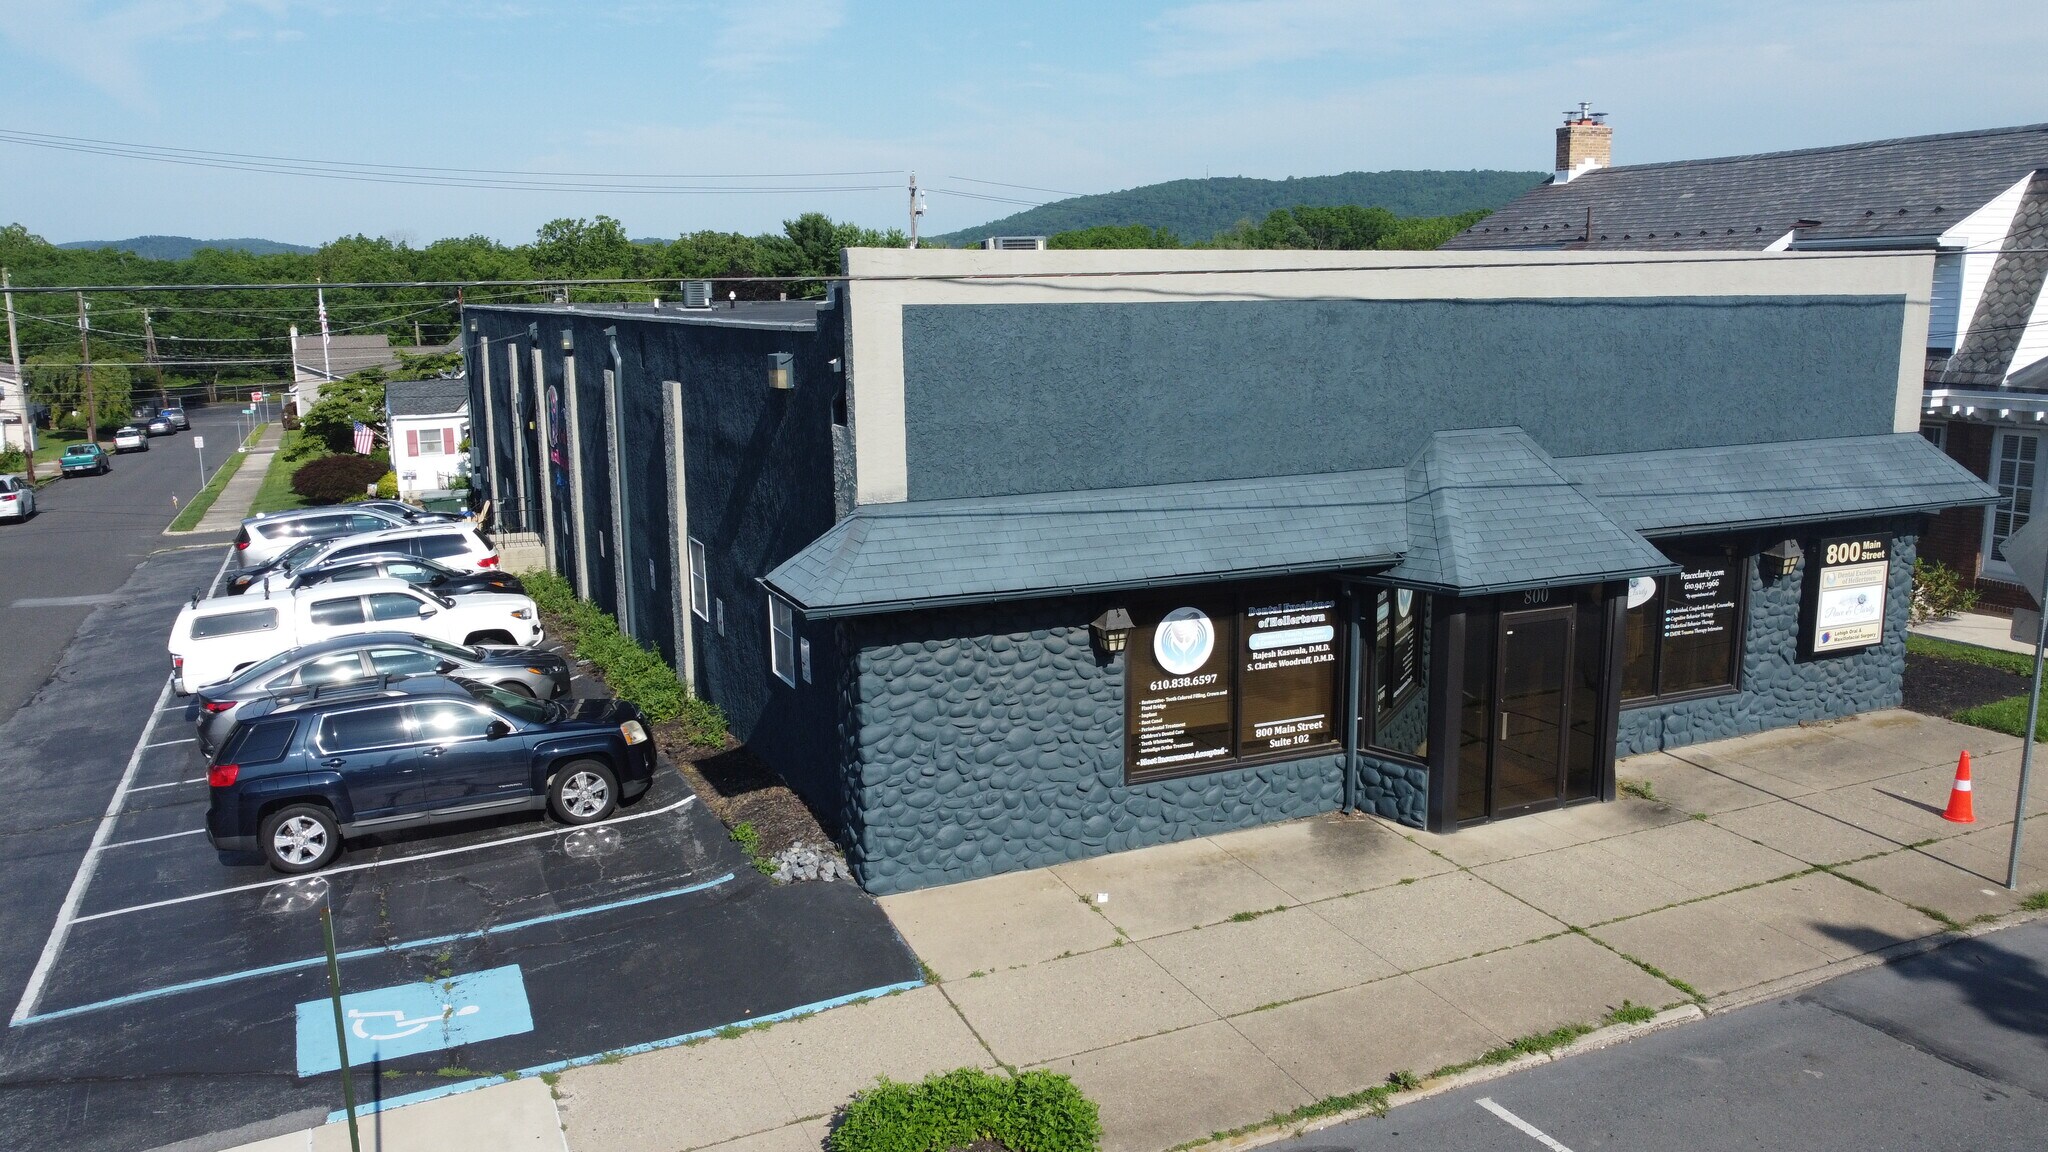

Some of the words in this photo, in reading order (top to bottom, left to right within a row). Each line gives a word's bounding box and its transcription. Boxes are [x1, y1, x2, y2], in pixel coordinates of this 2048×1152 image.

[1826, 541, 1861, 565] 800
[1863, 540, 1881, 550] Main
[1862, 550, 1885, 560] Street
[1680, 570, 1724, 580] Peaceclarity.com
[1684, 579, 1719, 590] 610.947.1966
[1524, 588, 1549, 604] 800
[1248, 603, 1282, 617] Dental
[1283, 600, 1335, 613] Excellence
[1258, 618, 1269, 628] of
[1269, 613, 1326, 628] Hellertown
[1253, 650, 1276, 660] Rajesh
[1278, 646, 1308, 656] Kaswala,
[1309, 644, 1330, 652] D.M.D.
[1254, 661, 1277, 670] Clarke
[1279, 657, 1312, 667] Woodruff,
[1314, 654, 1335, 662] D.M.D.
[1150, 673, 1218, 691] 610.838.6597
[1256, 728, 1272, 738] 800
[1274, 724, 1296, 735] Main
[1297, 721, 1322, 732] Street
[1270, 737, 1292, 748] Suite
[1293, 734, 1309, 744] 102
